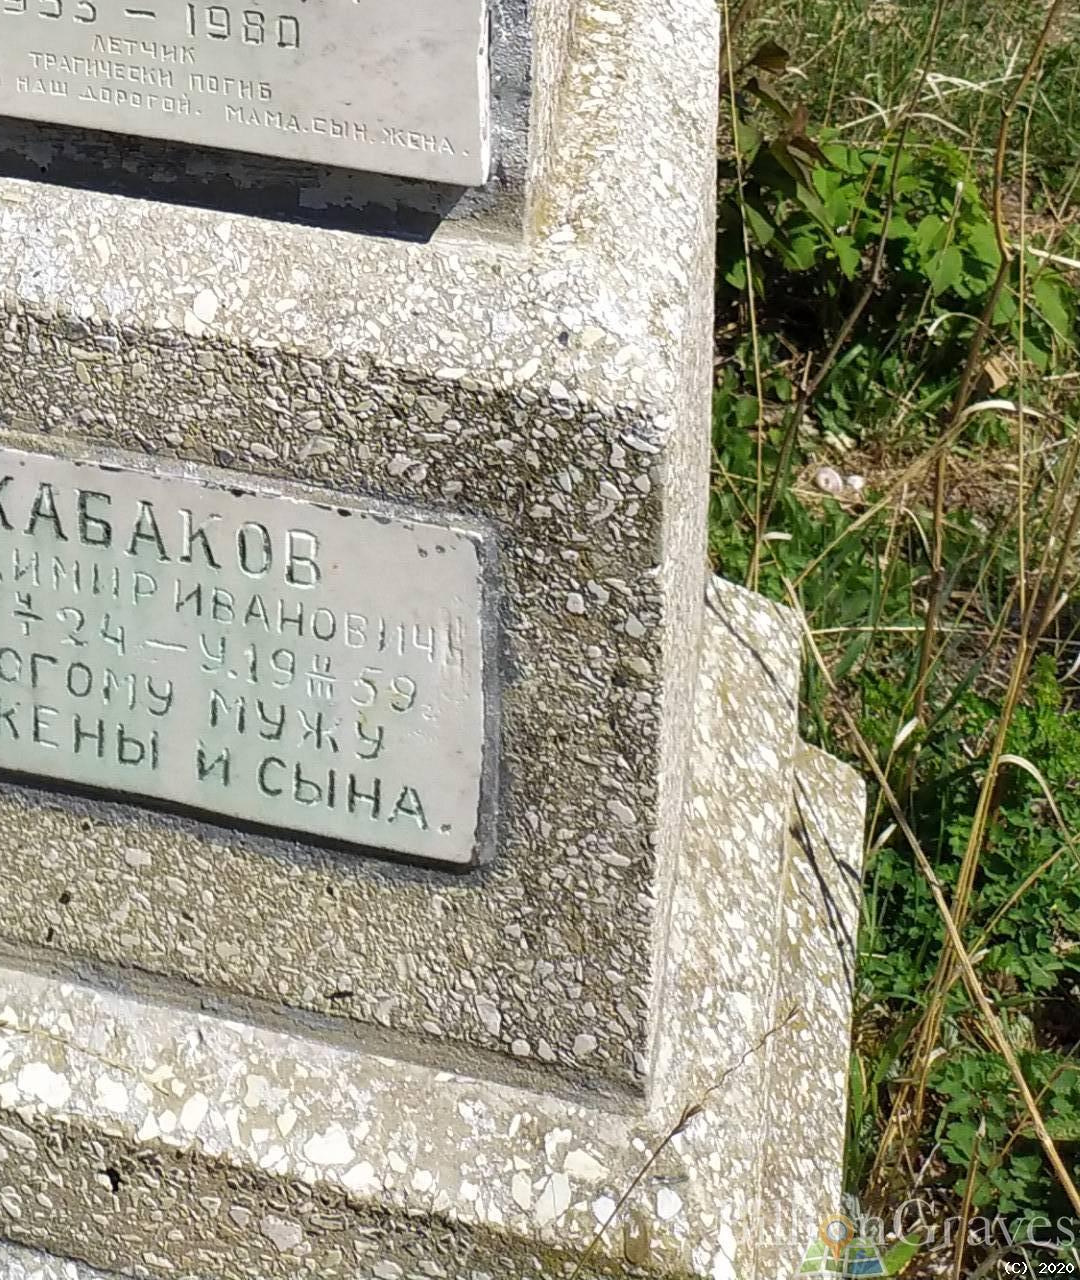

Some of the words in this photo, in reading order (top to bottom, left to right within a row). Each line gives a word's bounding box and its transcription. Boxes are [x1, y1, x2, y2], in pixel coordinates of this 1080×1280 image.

[91, 34, 196, 64] ЛЕТЧИК
[186, 3, 300, 49] 1980
[16, 77, 68, 96] НАШ
[28, 51, 173, 88] ТРАГИЧЕСКИ
[189, 73, 272, 101] ПОГИБ
[174, 578, 434, 662] ИВАНОВИЧ
[209, 689, 386, 760] МУЖУ
[197, 740, 230, 787] И
